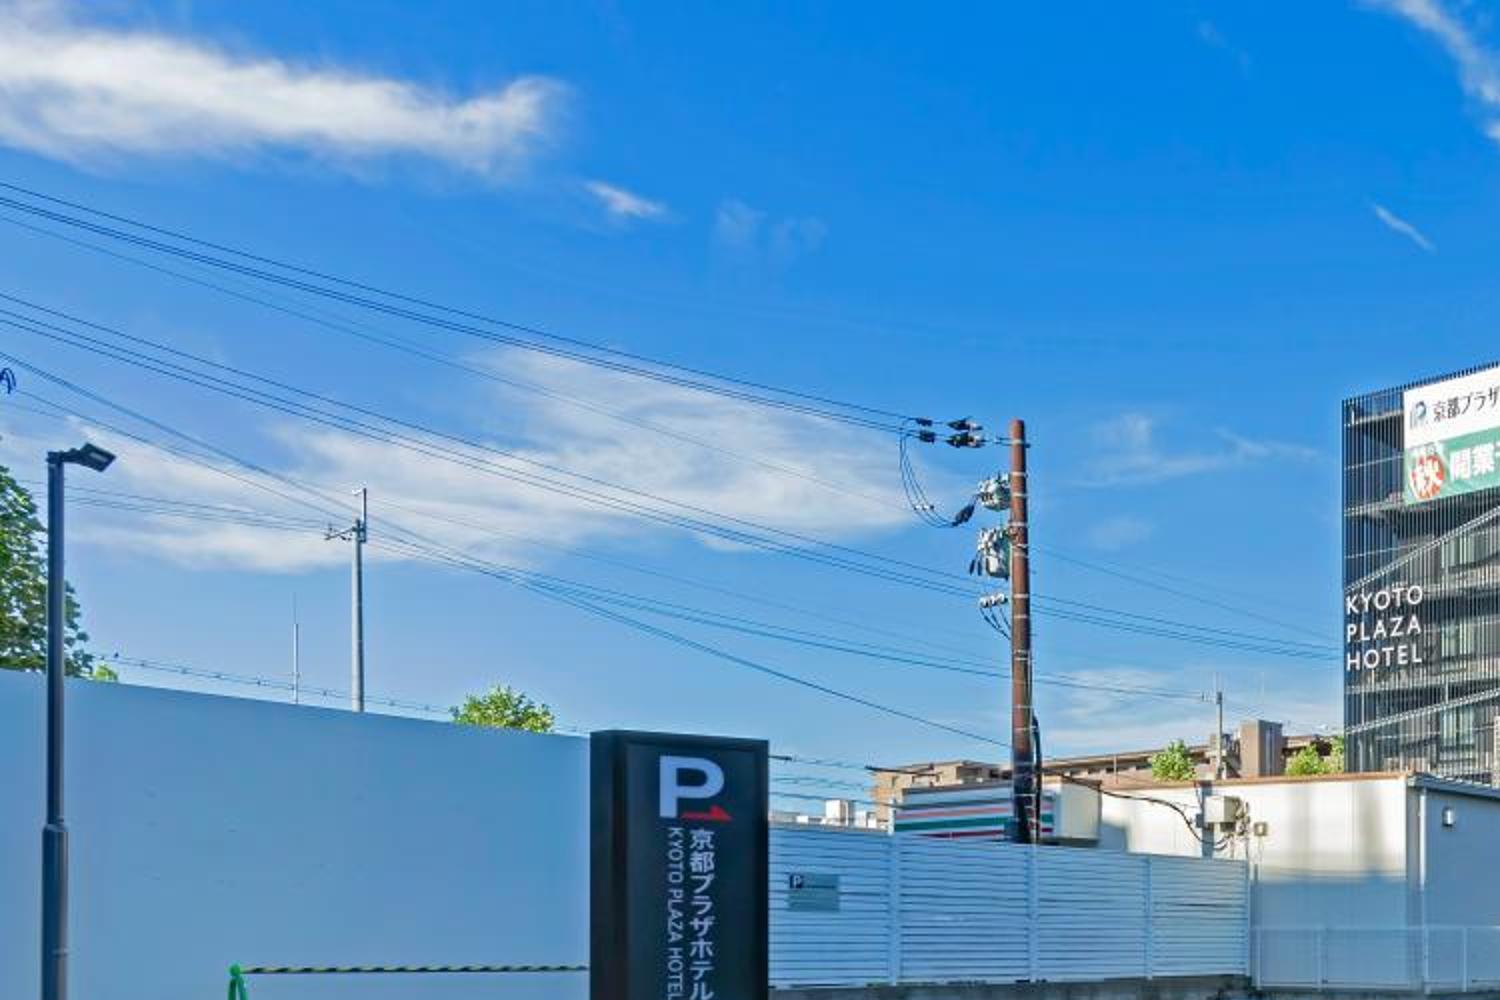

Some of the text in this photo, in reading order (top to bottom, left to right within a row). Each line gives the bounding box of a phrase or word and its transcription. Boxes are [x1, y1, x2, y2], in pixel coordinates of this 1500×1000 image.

[1346, 585, 1423, 615] KYOTO
[1346, 615, 1422, 643] PLAZA
[1346, 643, 1422, 671] HOTEL
[659, 756, 725, 818] P
[667, 828, 684, 883] KYOTO
[667, 889, 684, 943] PLAZA
